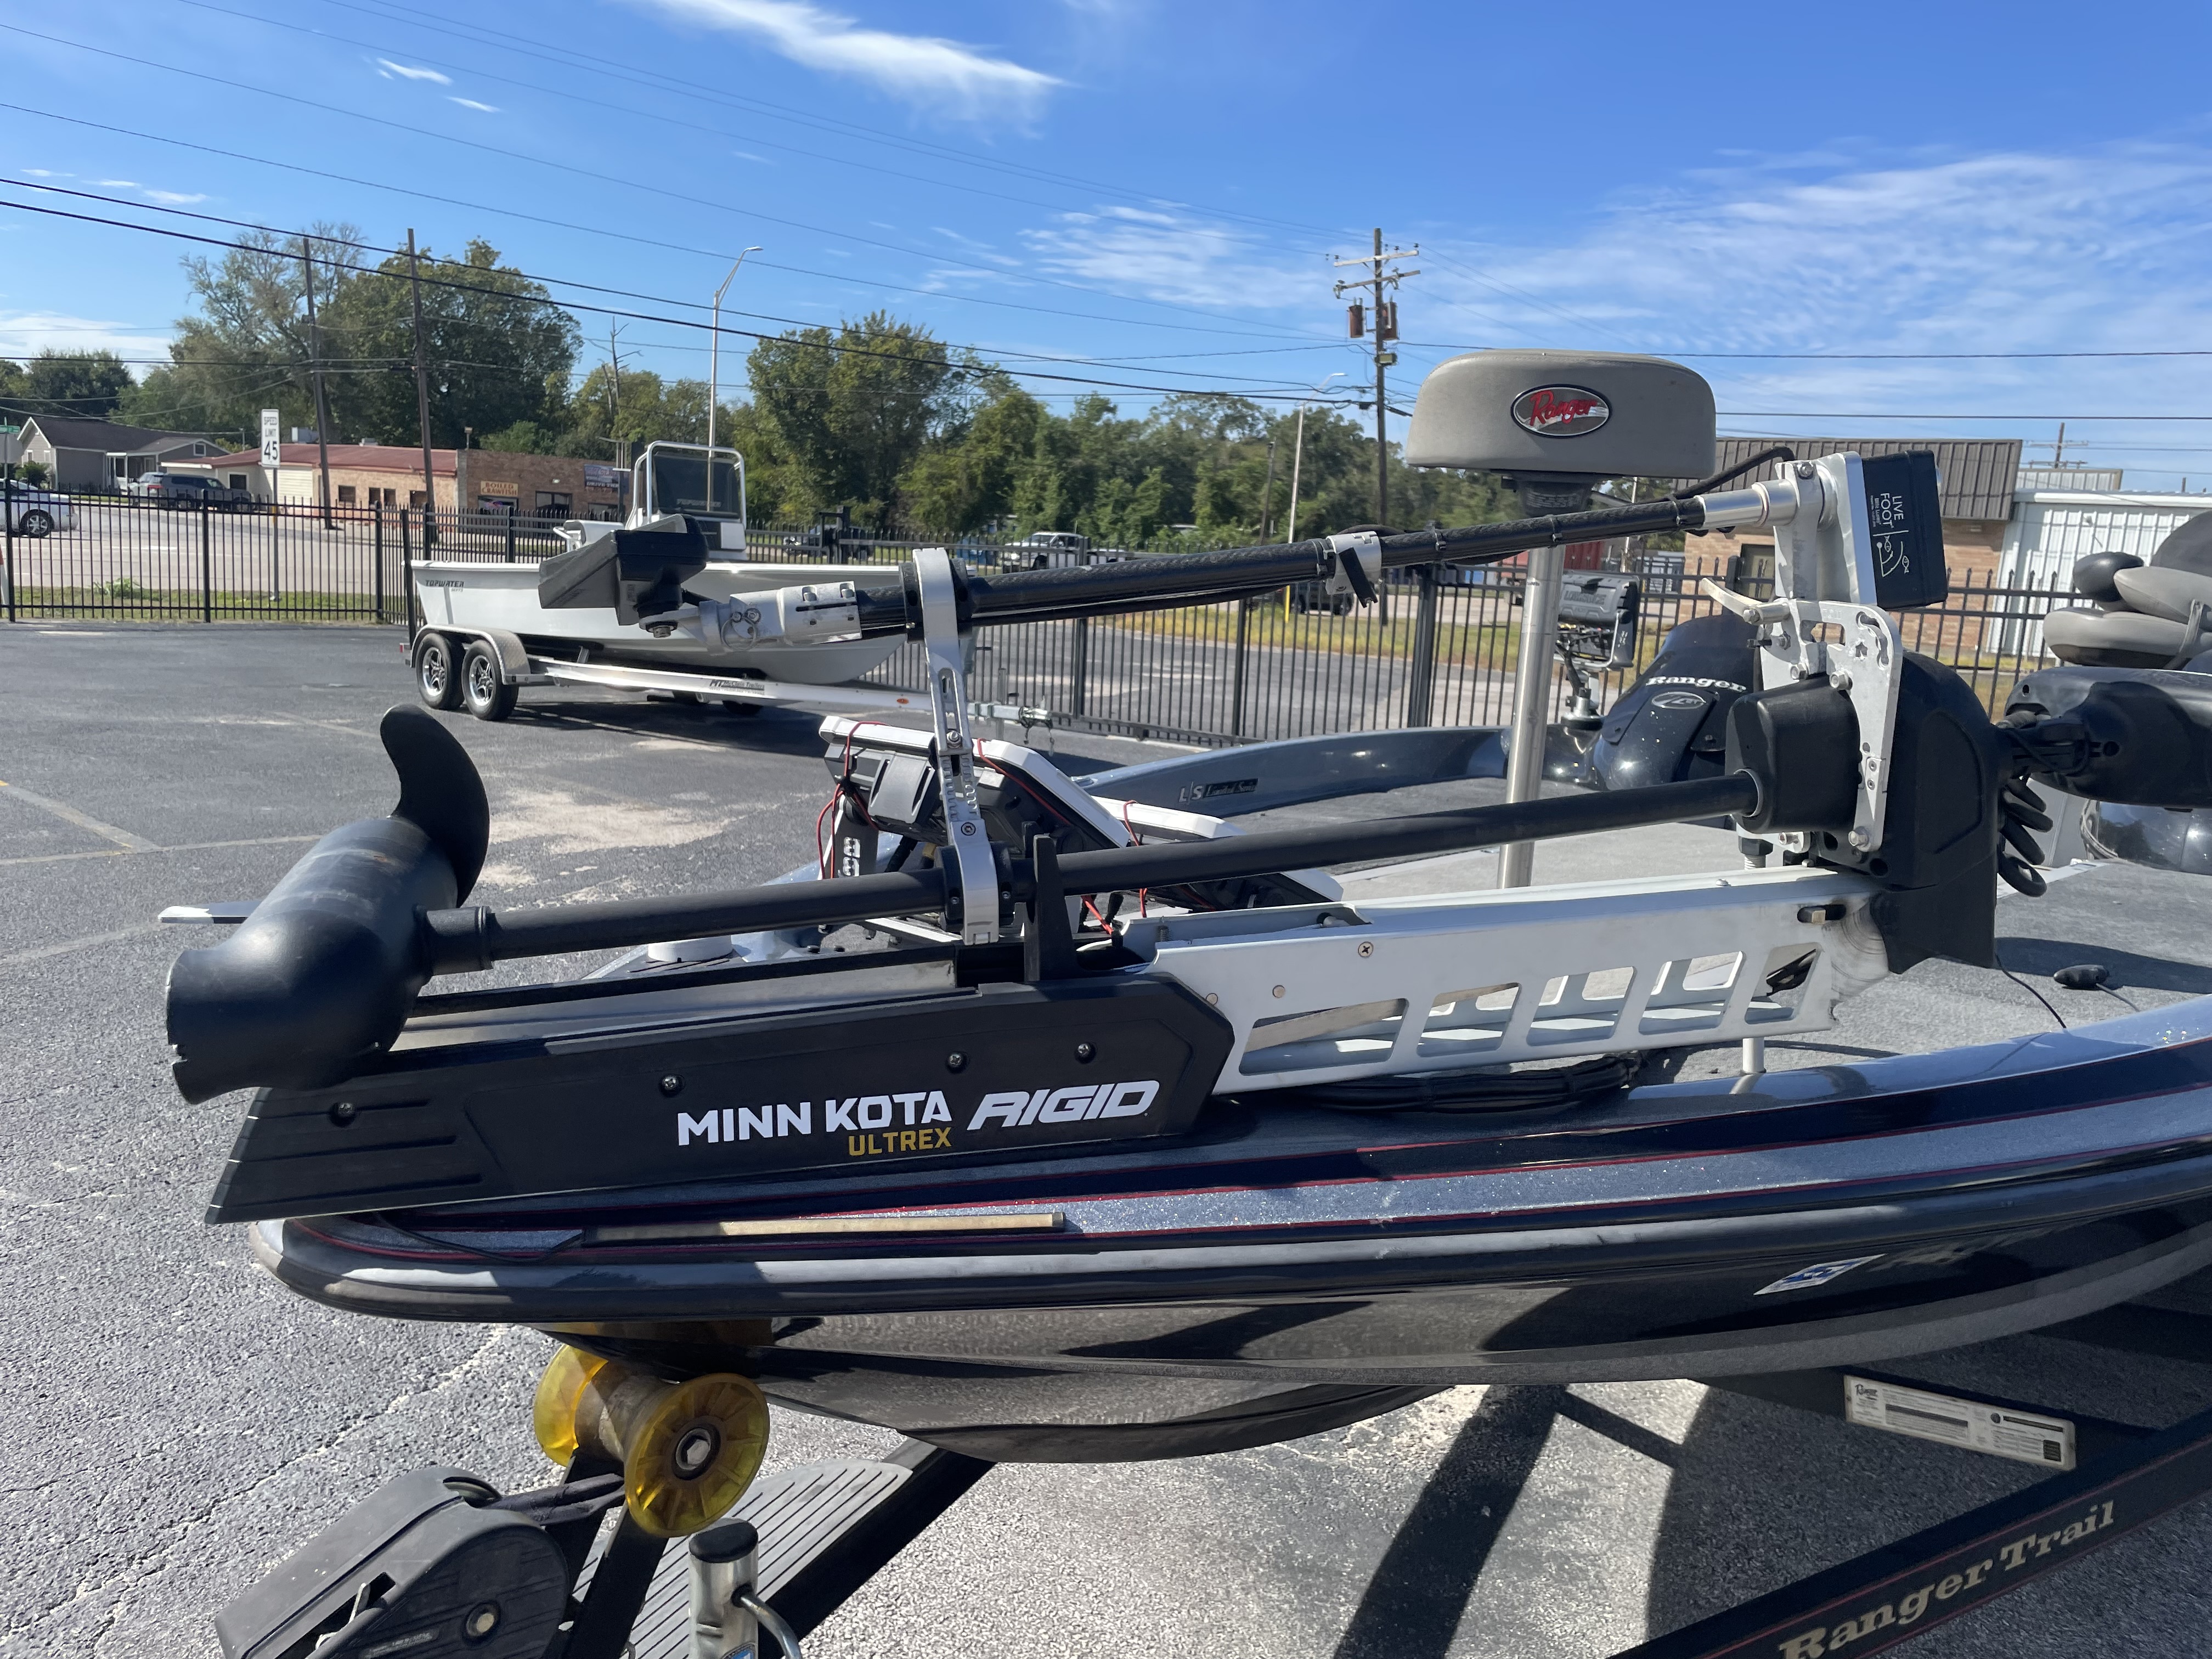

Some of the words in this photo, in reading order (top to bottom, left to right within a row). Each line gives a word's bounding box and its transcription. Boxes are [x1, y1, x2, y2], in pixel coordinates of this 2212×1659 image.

[263, 416, 278, 425] SPEED
[1530, 390, 1598, 426] Ranger
[265, 428, 276, 437] LIMIT
[264, 441, 278, 460] 45
[1892, 495, 1904, 521] LIVE
[425, 579, 464, 588] TOPWATER
[1645, 675, 1747, 693] Ranger
[678, 1102, 811, 1146] MINN
[825, 1091, 952, 1131] KOTA
[966, 1080, 1160, 1131] RIGID
[849, 1127, 952, 1156] ULTREX
[1778, 1558, 1994, 1659] Ranger
[2000, 1499, 2114, 1571] Trail
